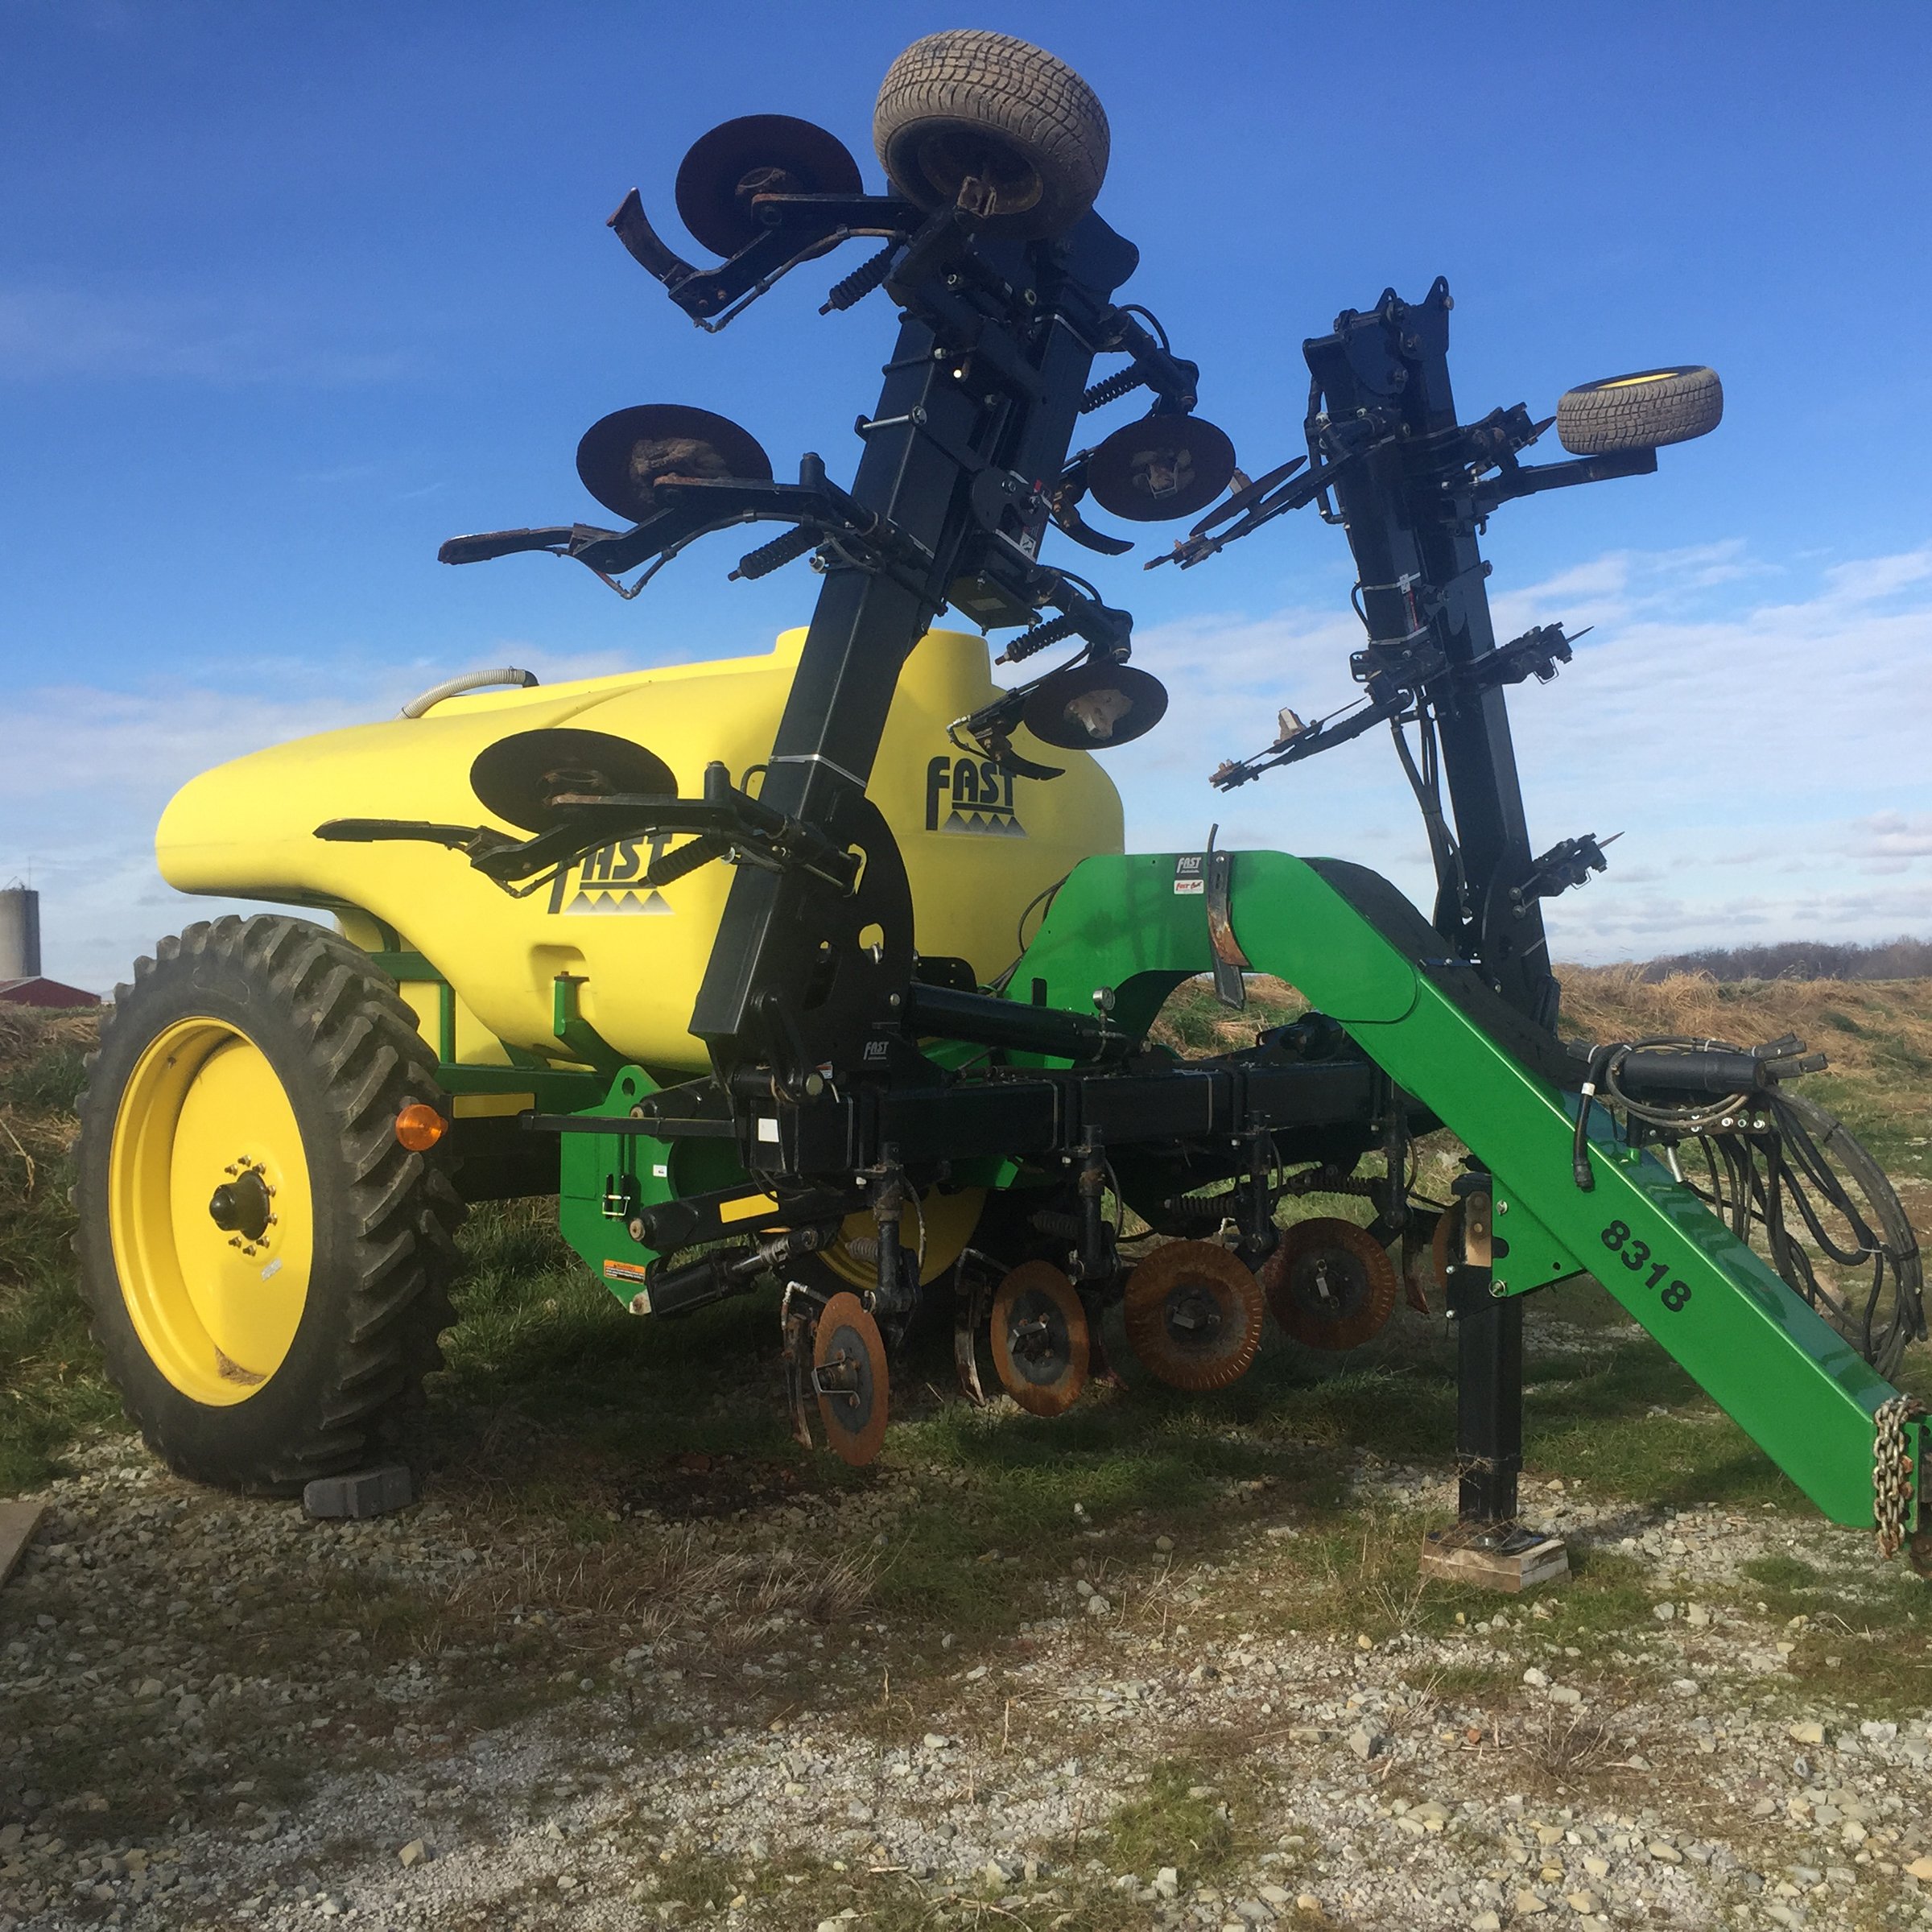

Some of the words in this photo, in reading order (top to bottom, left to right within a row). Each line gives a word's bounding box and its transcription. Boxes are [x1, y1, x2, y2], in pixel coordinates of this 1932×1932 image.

[926, 756, 1017, 831] FAST
[1176, 857, 1202, 873] FAST
[863, 1041, 890, 1060] FAST
[1601, 1220, 1692, 1313] 8318
